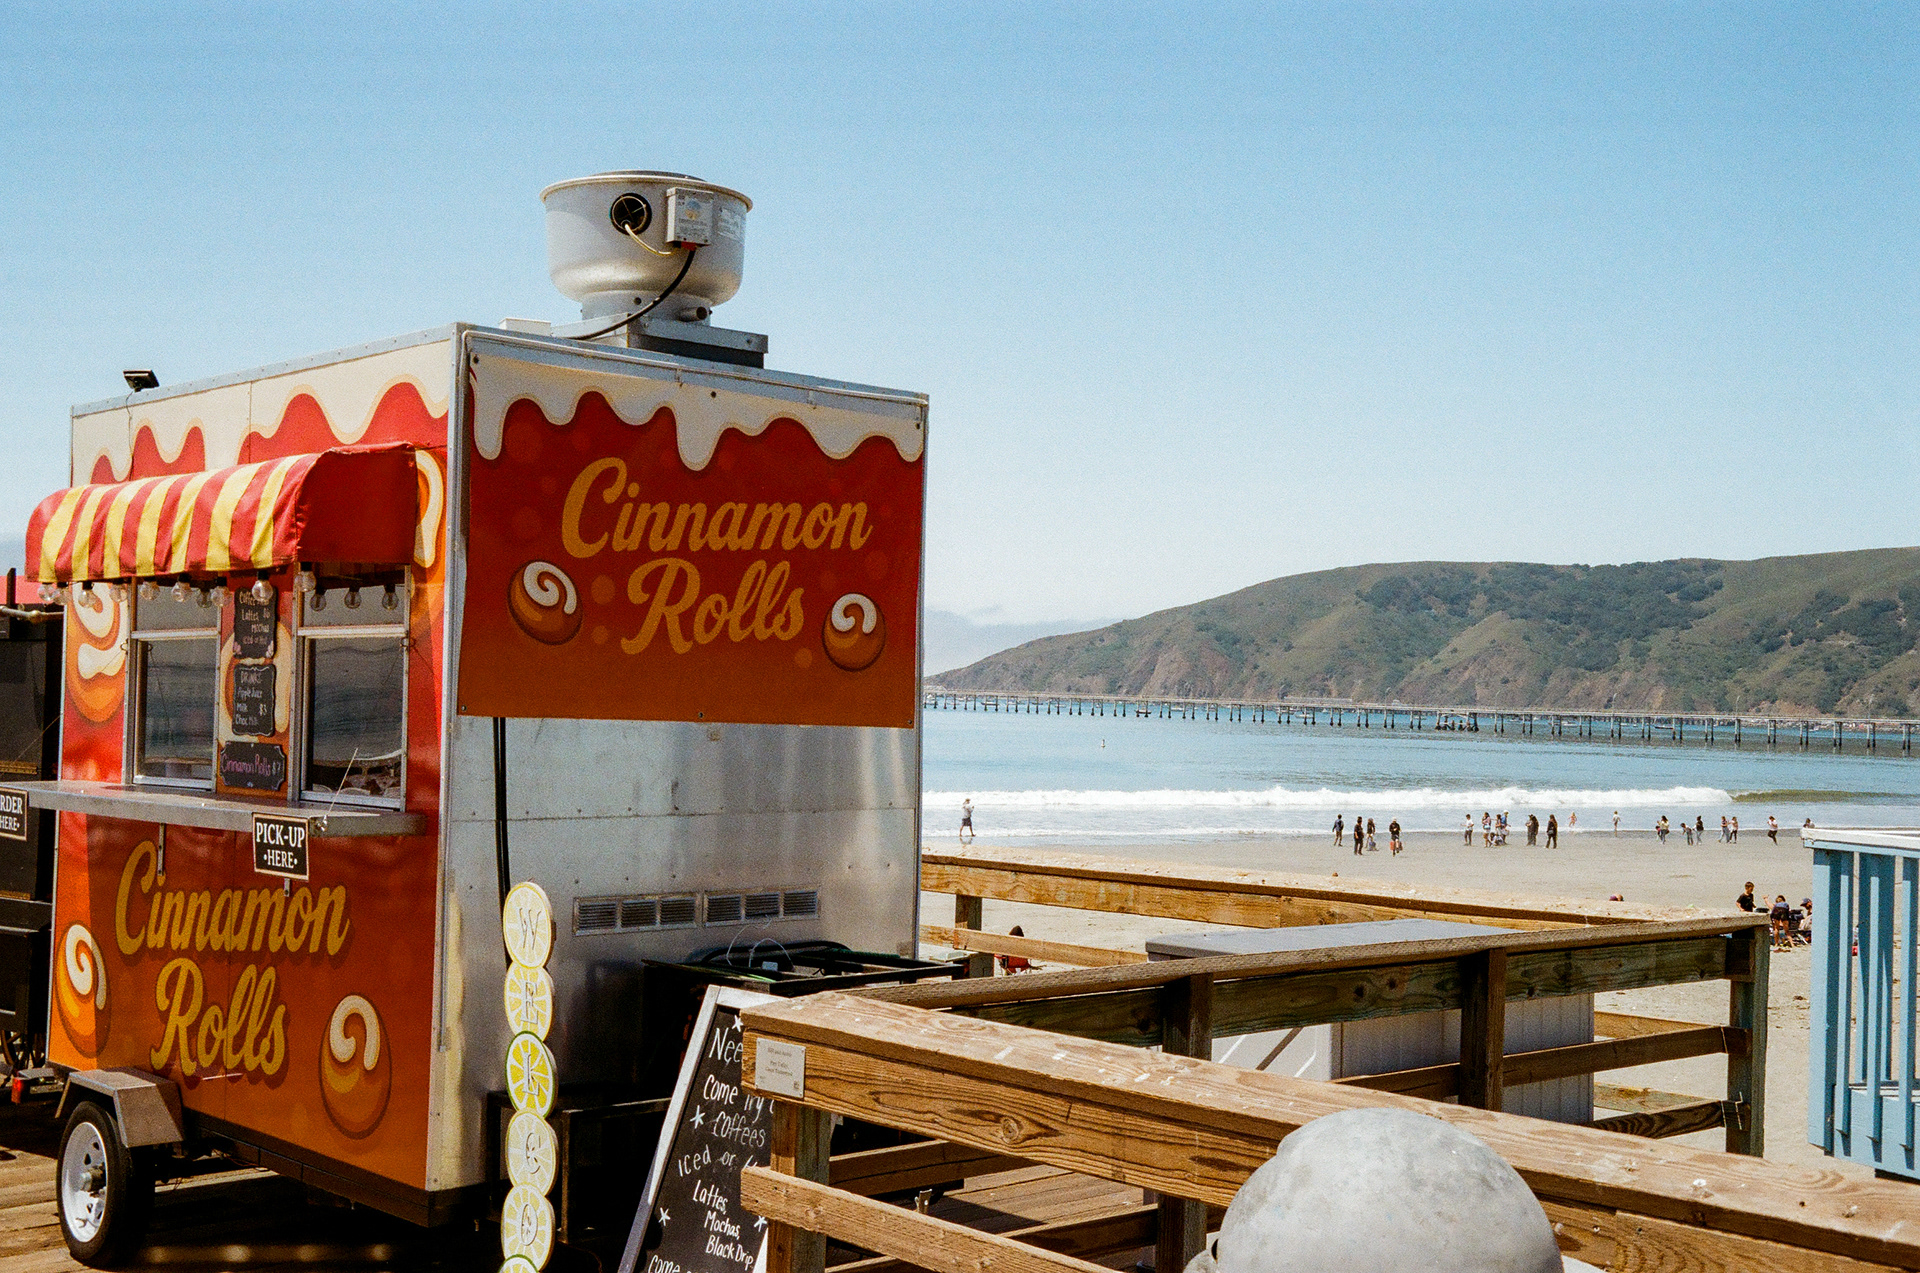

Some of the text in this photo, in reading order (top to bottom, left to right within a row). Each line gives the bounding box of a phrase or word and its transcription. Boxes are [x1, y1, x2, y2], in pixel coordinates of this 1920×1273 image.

[562, 457, 873, 558] Cinnamon
[620, 557, 804, 654] Rolls
[220, 753, 255, 774] Cinnamon
[256, 822, 305, 848] PICK-UP
[115, 841, 350, 956] Cinnamon
[150, 957, 286, 1076] Rolls
[703, 1074, 738, 1105] Come
[721, 1151, 736, 1166] or
[692, 1179, 729, 1215] Lattes,
[704, 1210, 740, 1240] Mochas,
[705, 1234, 735, 1260] Black
